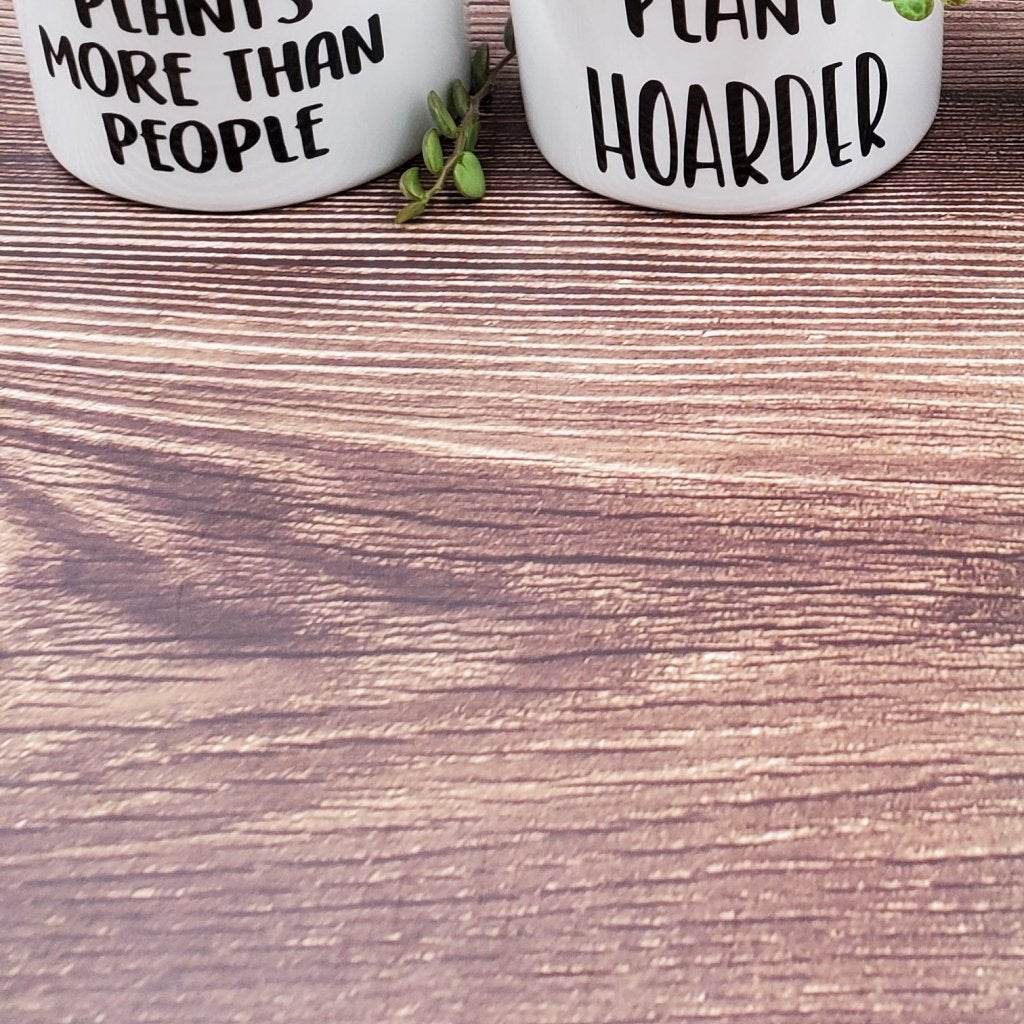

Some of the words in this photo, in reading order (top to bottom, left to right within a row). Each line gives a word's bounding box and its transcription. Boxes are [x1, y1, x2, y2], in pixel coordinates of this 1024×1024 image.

[38, 24, 199, 107] MORE
[223, 13, 385, 103] THAN
[101, 103, 330, 174] PEOPLE
[586, 51, 888, 189] HOARDER
